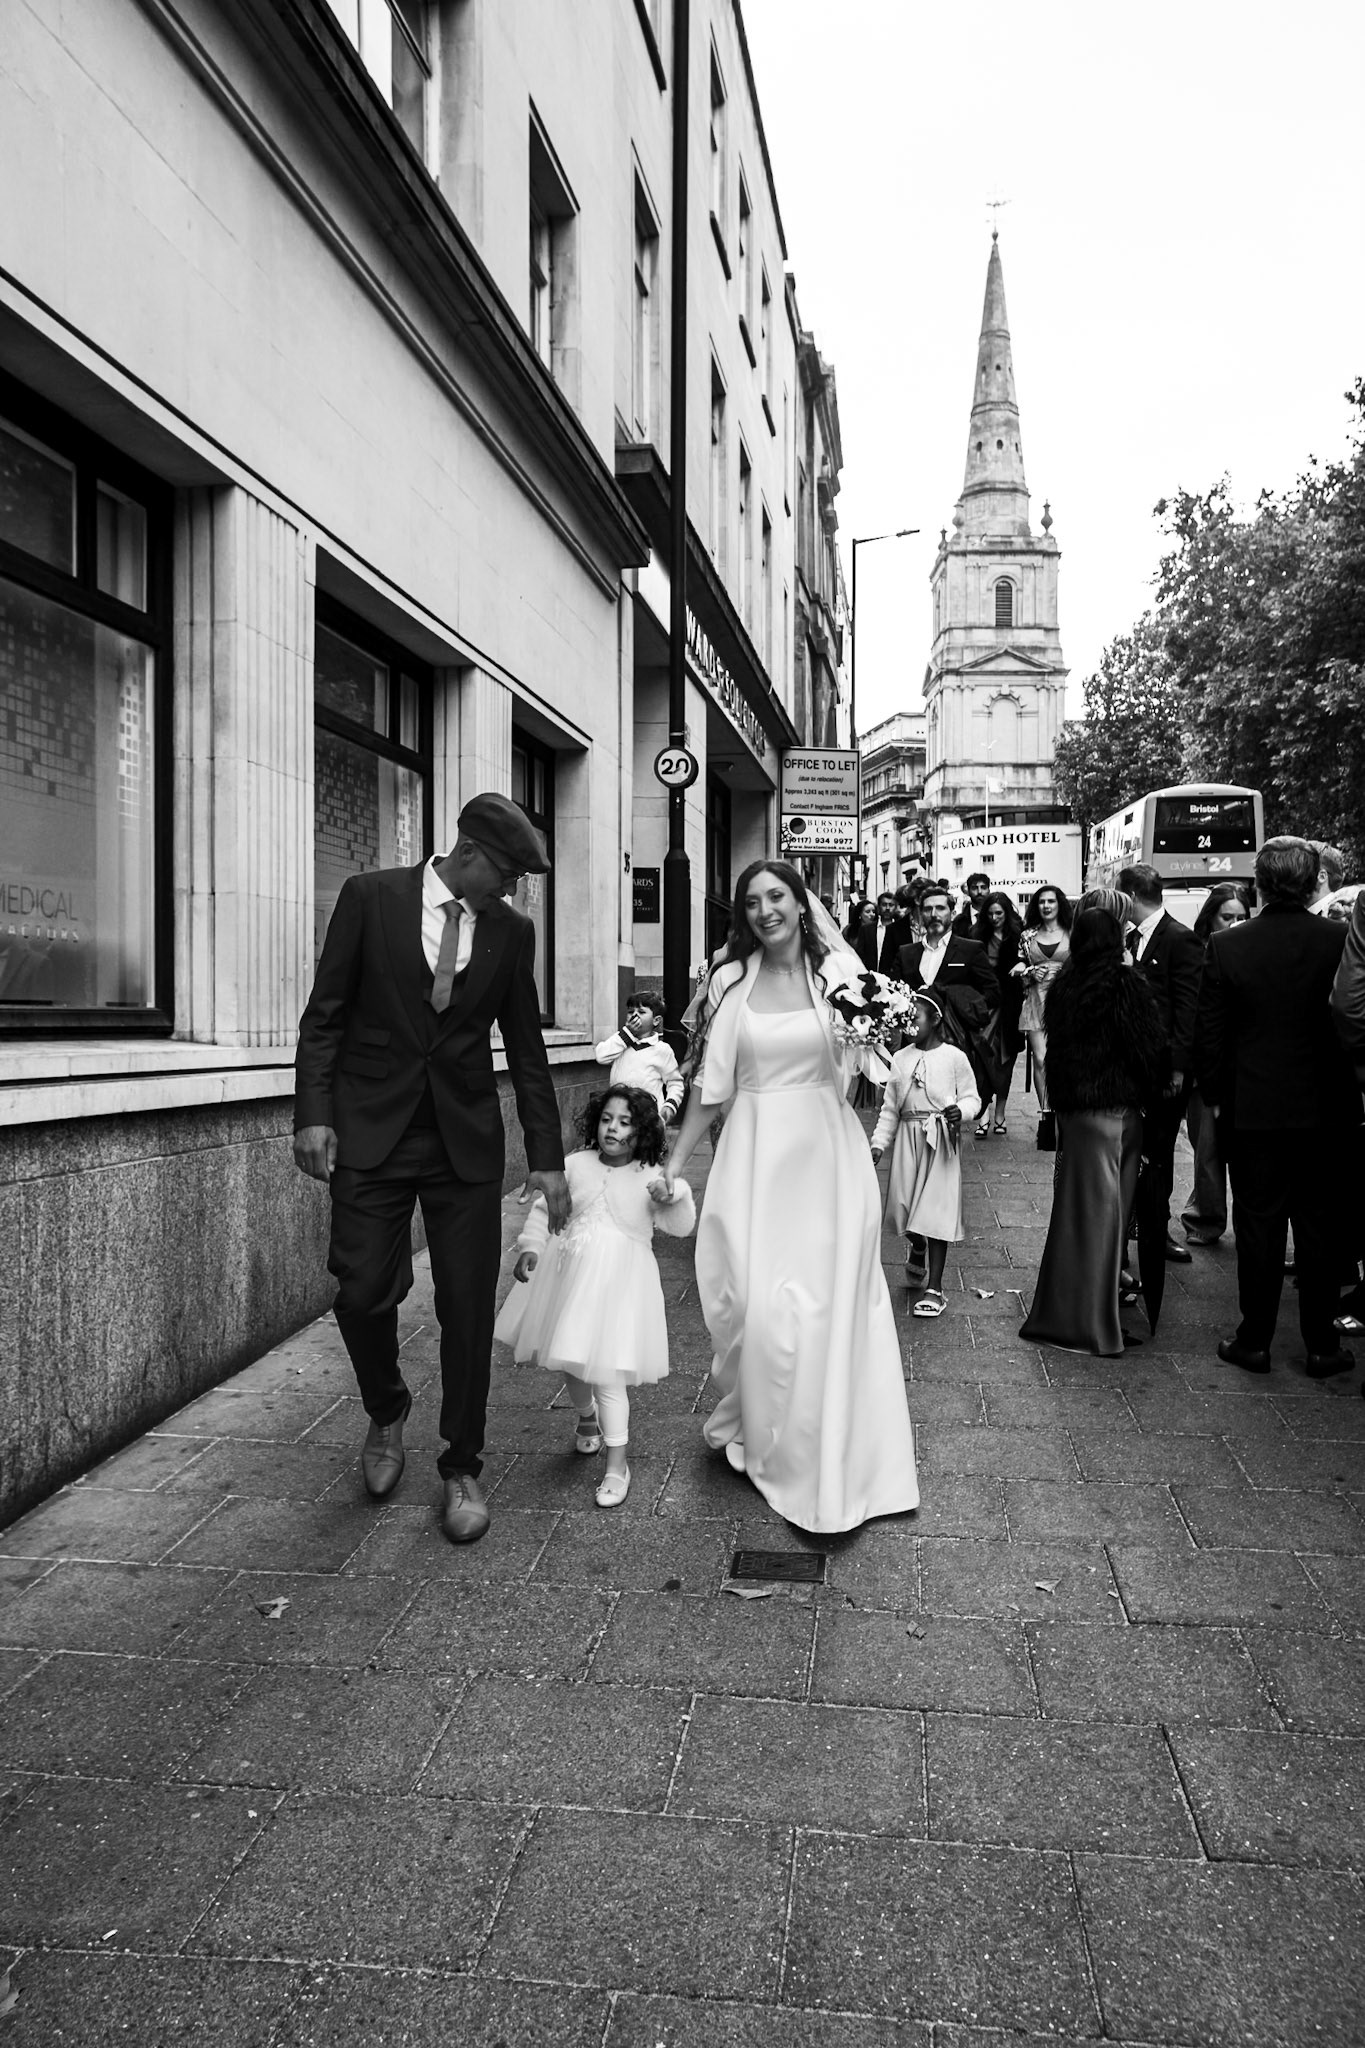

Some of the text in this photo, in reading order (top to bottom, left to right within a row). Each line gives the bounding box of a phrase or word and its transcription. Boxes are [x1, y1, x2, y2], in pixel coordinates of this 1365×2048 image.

[685, 604, 725, 688] WARDS
[661, 758, 689, 774] 20
[784, 758, 856, 771] OFFICE TO LET
[1190, 804, 1219, 813] Bristol
[807, 819, 853, 827] BURSTON
[951, 834, 998, 850] GRAND
[1002, 832, 1061, 844] HOTEL
[1197, 835, 1212, 848] 24
[1208, 856, 1233, 872] 24
